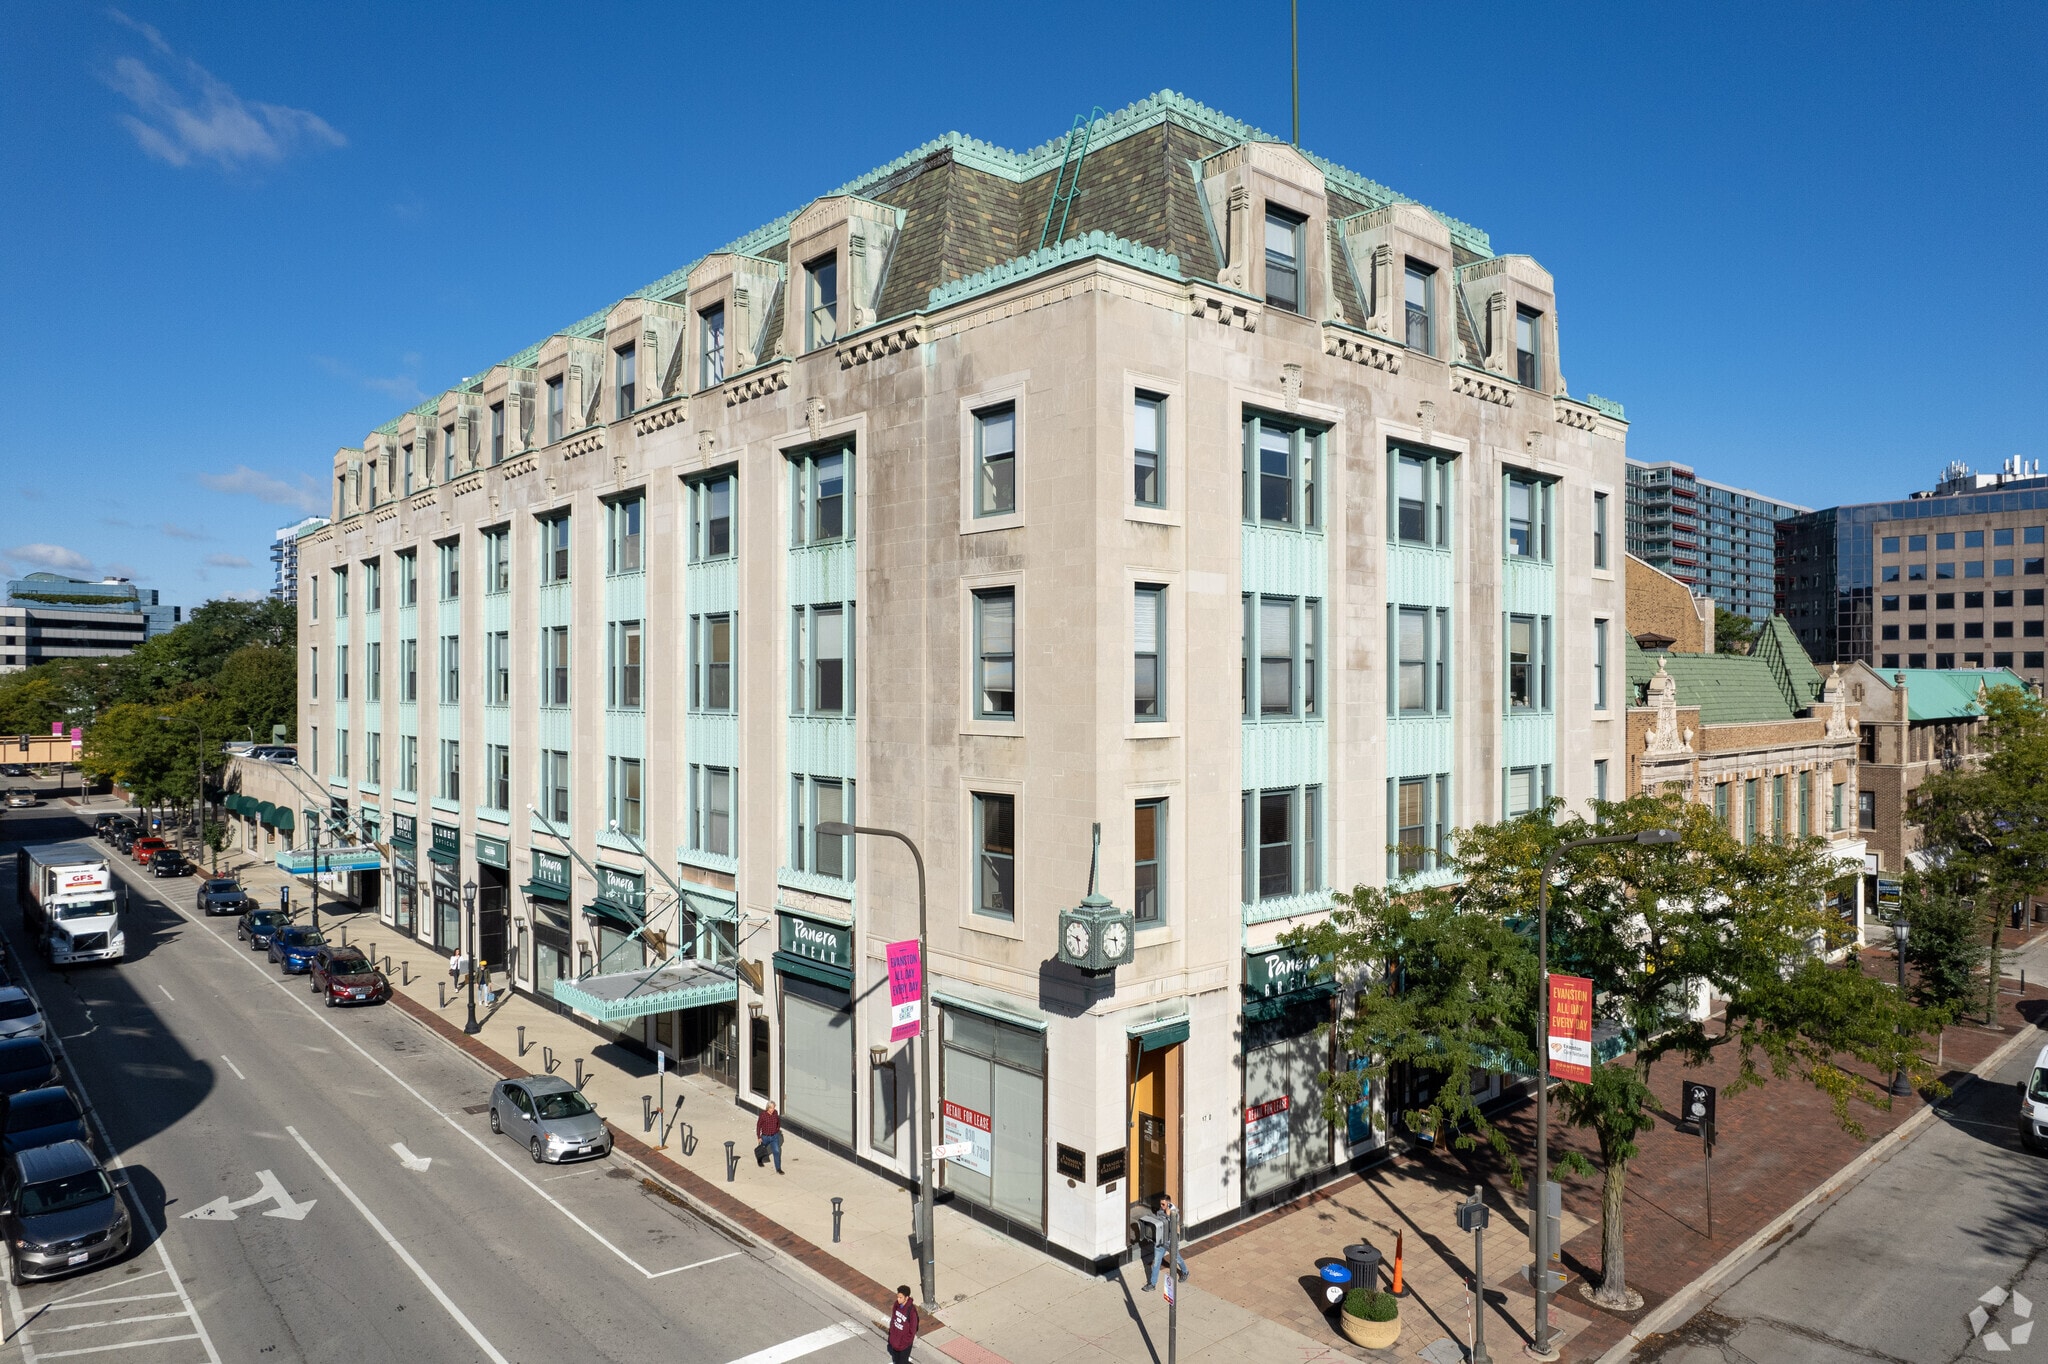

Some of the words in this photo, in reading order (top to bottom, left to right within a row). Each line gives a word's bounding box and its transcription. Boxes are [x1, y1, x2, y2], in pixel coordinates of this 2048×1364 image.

[539, 853, 562, 872] Panera
[72, 874, 94, 882] GFS
[606, 870, 634, 890] Panera
[792, 918, 837, 948] Panera
[792, 940, 836, 964] BREAD
[890, 954, 918, 968] EVANSTON
[894, 970, 904, 981] ALL
[905, 968, 915, 980] DAY
[892, 984, 907, 996] EVERY
[908, 981, 918, 993] DAY
[1553, 987, 1588, 1002] EVANSTON
[1556, 1002, 1569, 1015] ALL
[1570, 1004, 1584, 1016] DAY
[1552, 1016, 1574, 1029] EVERY
[1575, 1019, 1588, 1031] DAY
[945, 1103, 962, 1120] RETAIL
[963, 1109, 973, 1125] FOR
[973, 1113, 990, 1131] LEASE
